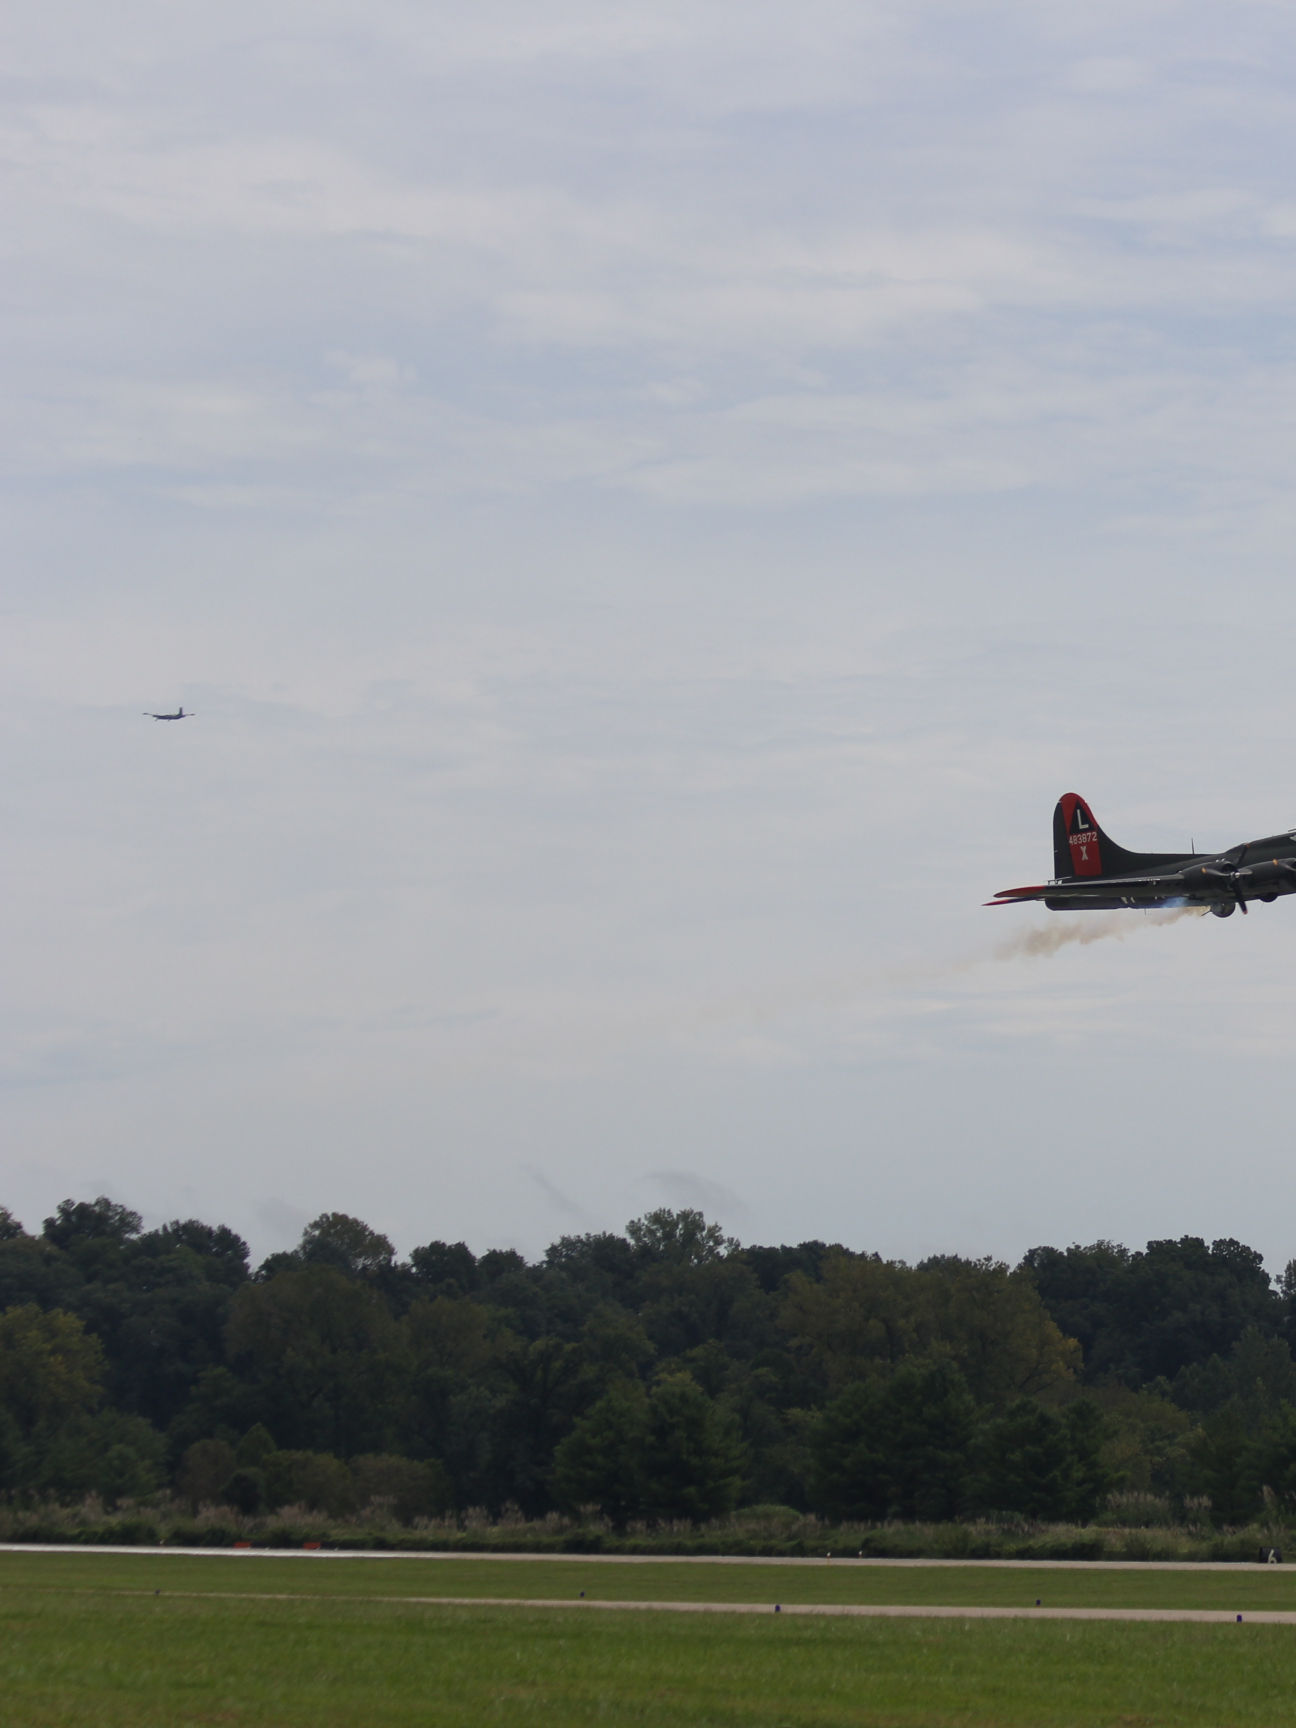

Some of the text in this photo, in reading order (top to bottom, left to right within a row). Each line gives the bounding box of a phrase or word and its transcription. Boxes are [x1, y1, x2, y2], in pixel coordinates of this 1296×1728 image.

[1077, 809, 1089, 829] L
[1069, 831, 1098, 845] 483872
[1080, 845, 1089, 861] X
